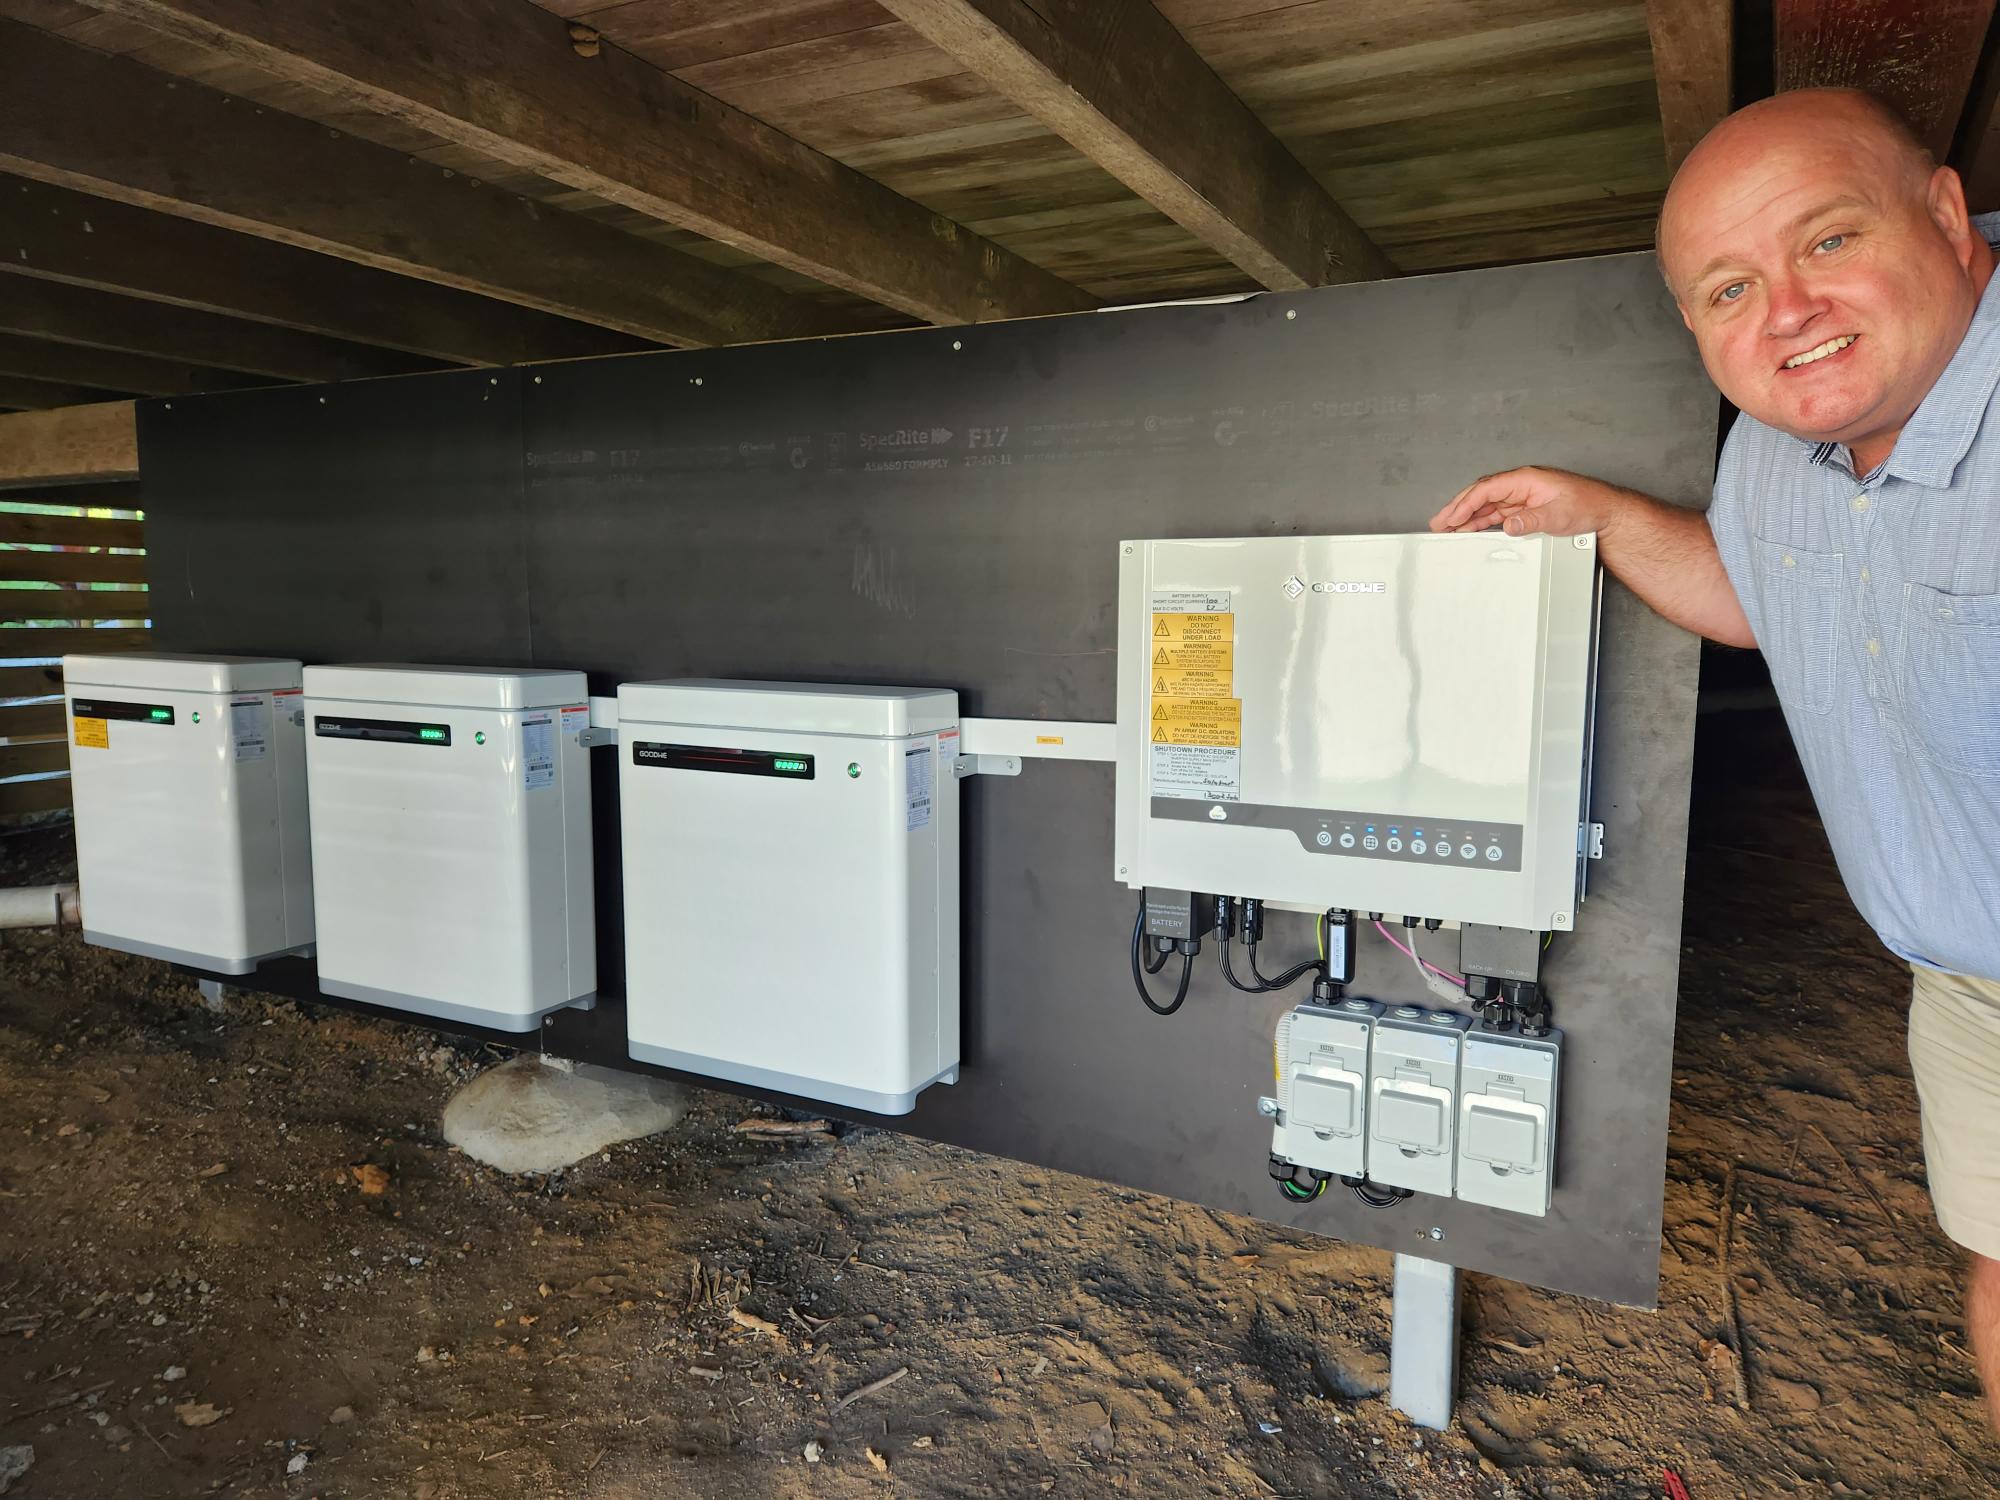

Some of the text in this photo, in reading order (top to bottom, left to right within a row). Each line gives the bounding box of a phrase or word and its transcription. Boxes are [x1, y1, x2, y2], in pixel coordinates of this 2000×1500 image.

[859, 430, 929, 450] SpecRite
[968, 426, 1009, 449] F17
[1311, 582, 1385, 593] GOODWE
[639, 750, 668, 760] GOODWE
[1154, 746, 1237, 756] SHUTDOWN PROCEDURE
[1151, 918, 1183, 928] BATTERY
